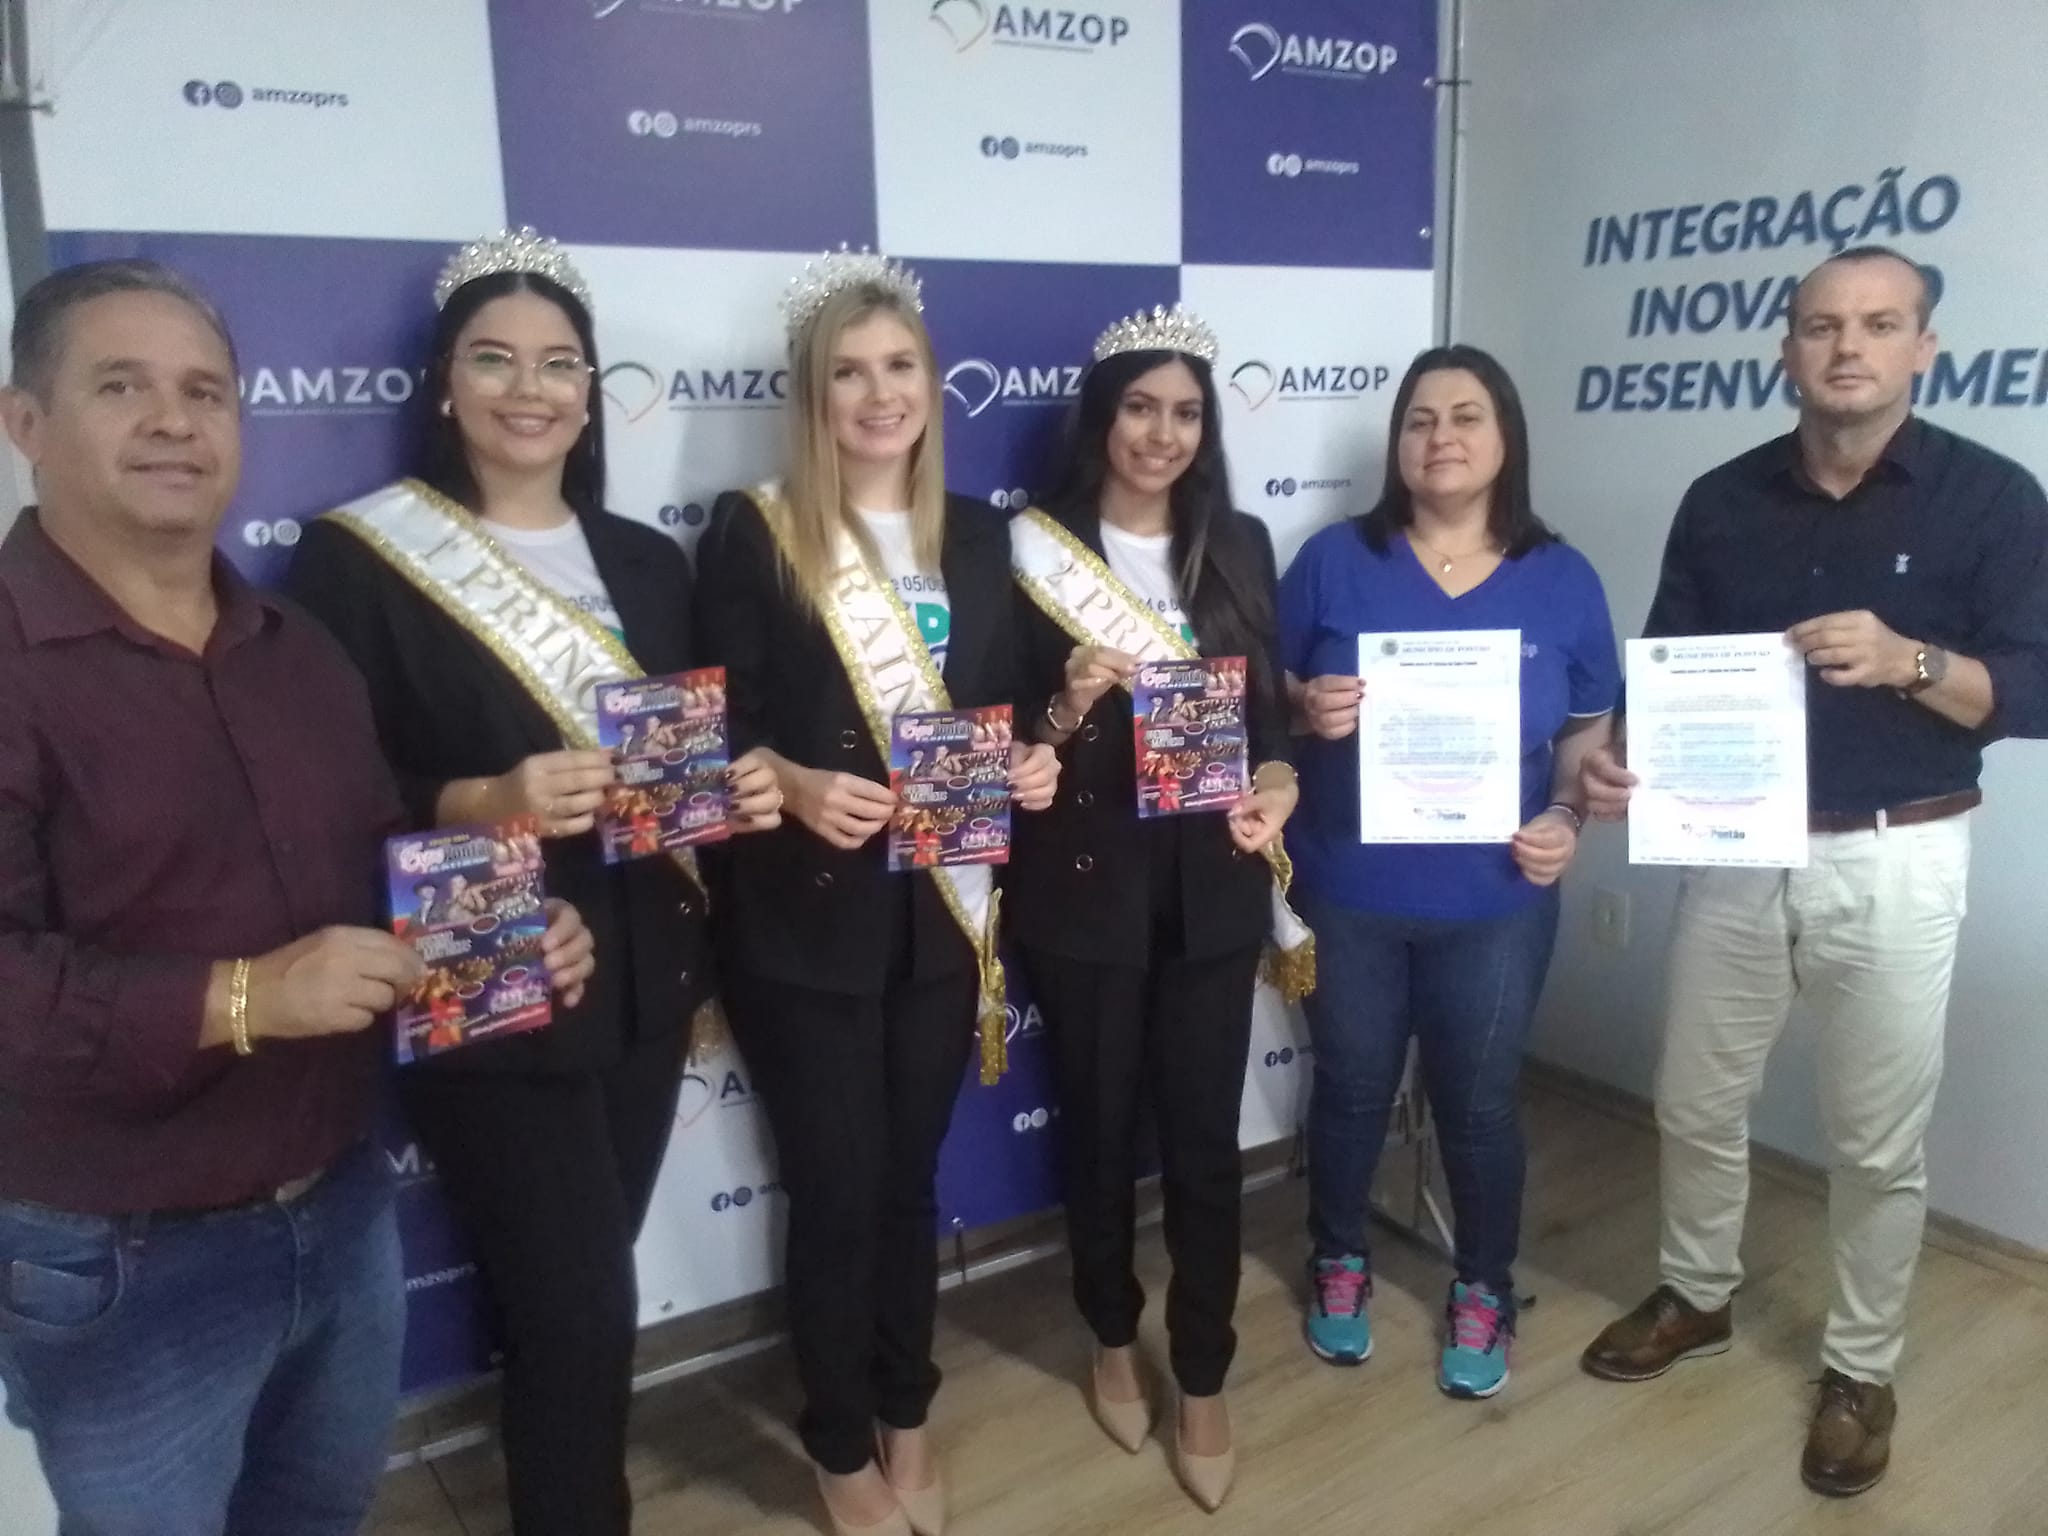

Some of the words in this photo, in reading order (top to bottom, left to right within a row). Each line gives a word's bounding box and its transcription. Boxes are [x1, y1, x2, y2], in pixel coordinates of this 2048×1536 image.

[992, 6, 1130, 47] AMZOP
[1281, 33, 1399, 75] AMZOP
[252, 87, 349, 107] amzoprs
[683, 117, 762, 138] amzoprs
[1024, 140, 1088, 158] amzoprs
[1304, 158, 1360, 175] amzoprs
[1583, 166, 1960, 268] INTEGRAÇÃO
[250, 366, 415, 404] AMZO
[1002, 366, 1082, 397] AMZ
[1279, 366, 1390, 393] AMZOP
[1075, 586, 1162, 659] PRI
[407, 1261, 478, 1291] mzoprs
